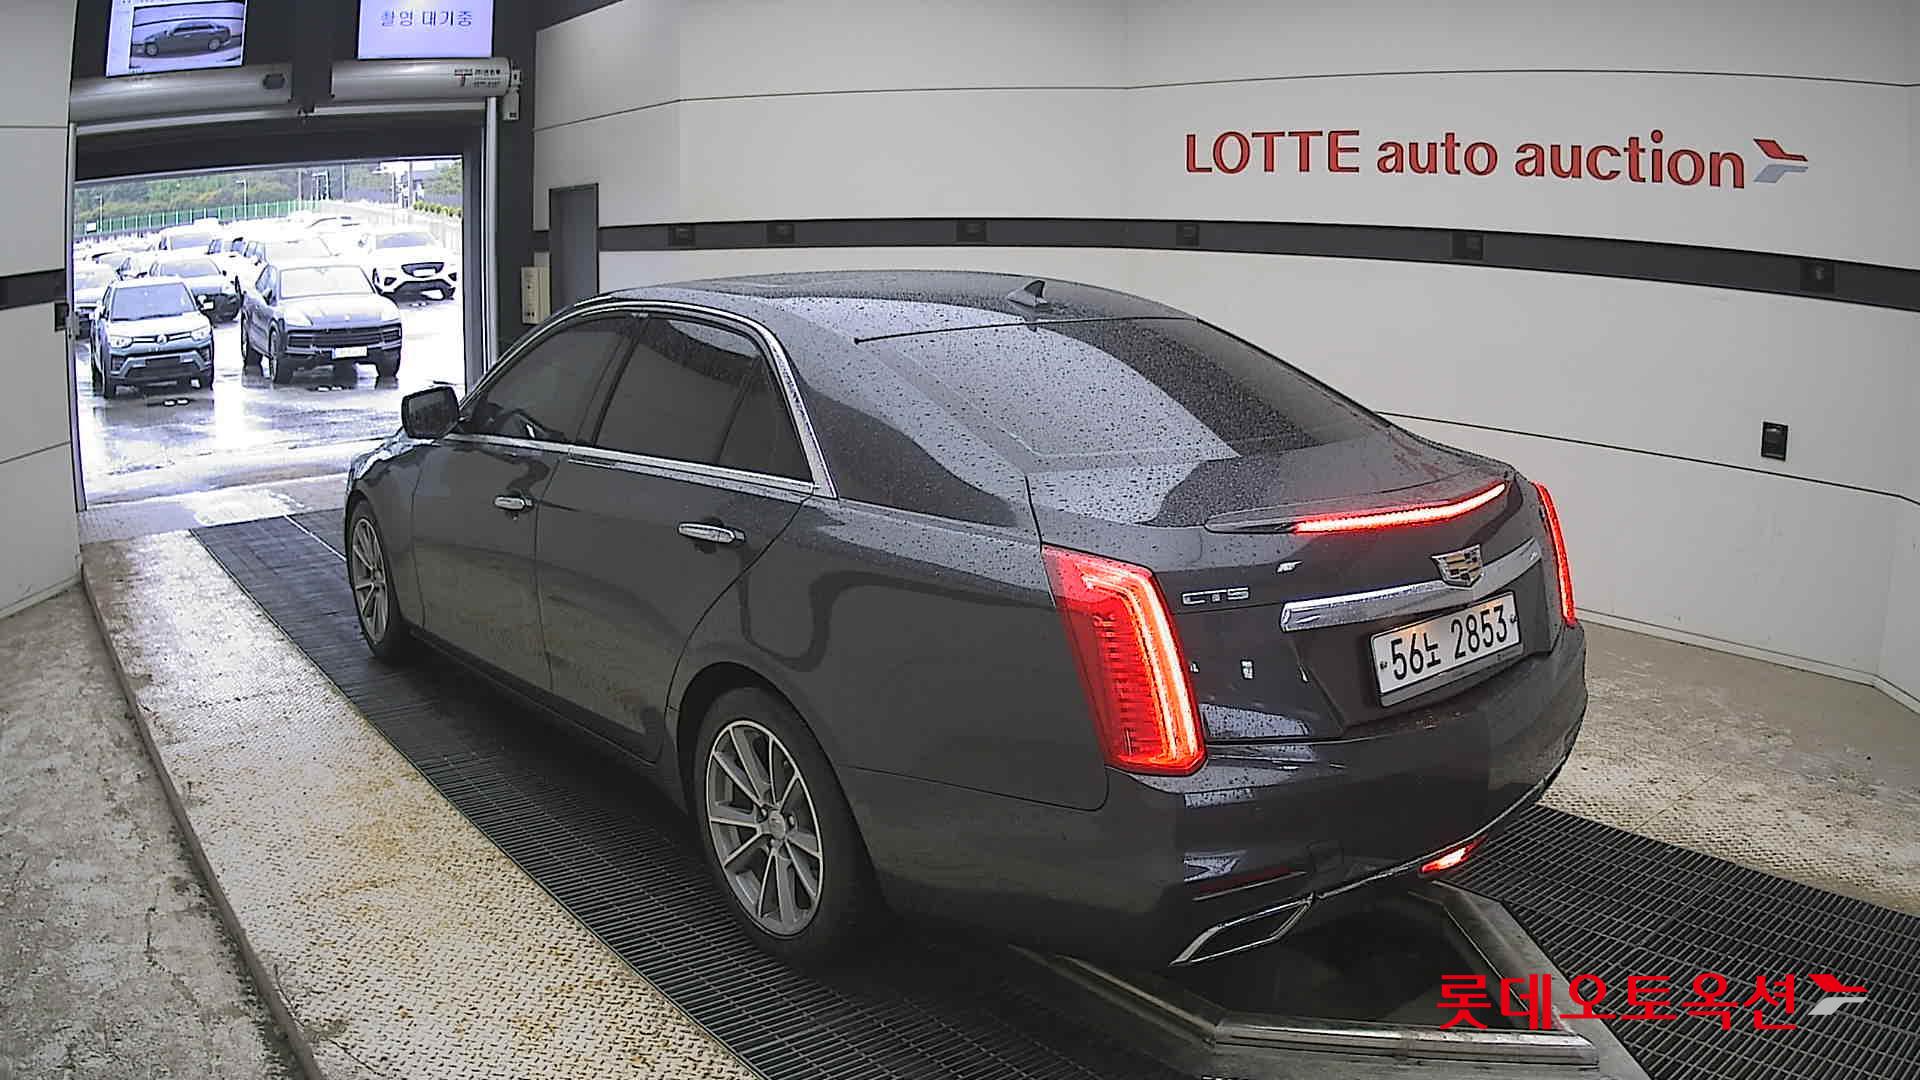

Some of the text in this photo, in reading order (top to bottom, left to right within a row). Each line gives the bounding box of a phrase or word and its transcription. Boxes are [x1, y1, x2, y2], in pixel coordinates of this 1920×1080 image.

[421, 10, 473, 27] 대기중
[1185, 129, 1745, 189] LOTTE auto auction
[1182, 587, 1249, 605] CTS
[1389, 604, 1509, 681] 56노 2853
